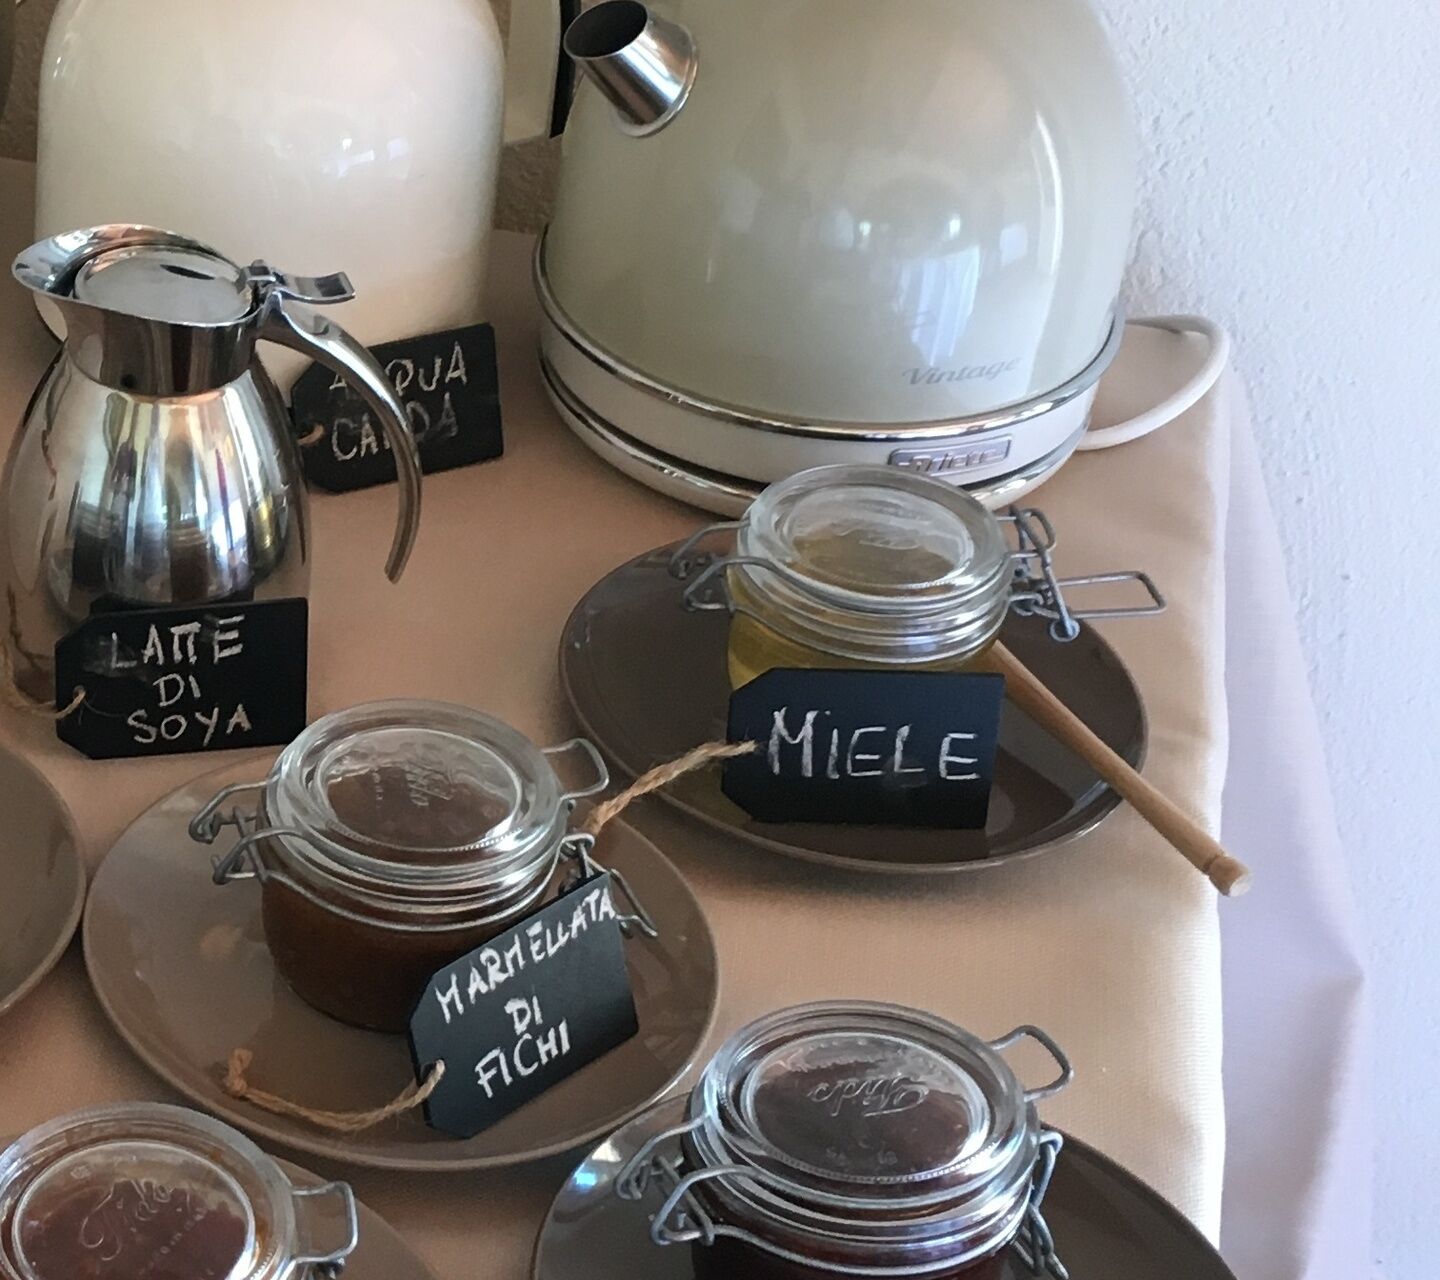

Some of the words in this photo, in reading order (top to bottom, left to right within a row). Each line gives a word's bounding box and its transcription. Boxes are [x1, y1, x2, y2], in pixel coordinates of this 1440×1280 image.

[902, 357, 1022, 385] Vintage
[331, 392, 459, 461] CADA
[109, 615, 246, 669] LATTE
[153, 673, 202, 707] DI
[126, 705, 252, 747] SOYA
[434, 884, 617, 1023] MARMELLATA
[504, 994, 544, 1036] DI
[475, 1019, 571, 1100] FICHI
